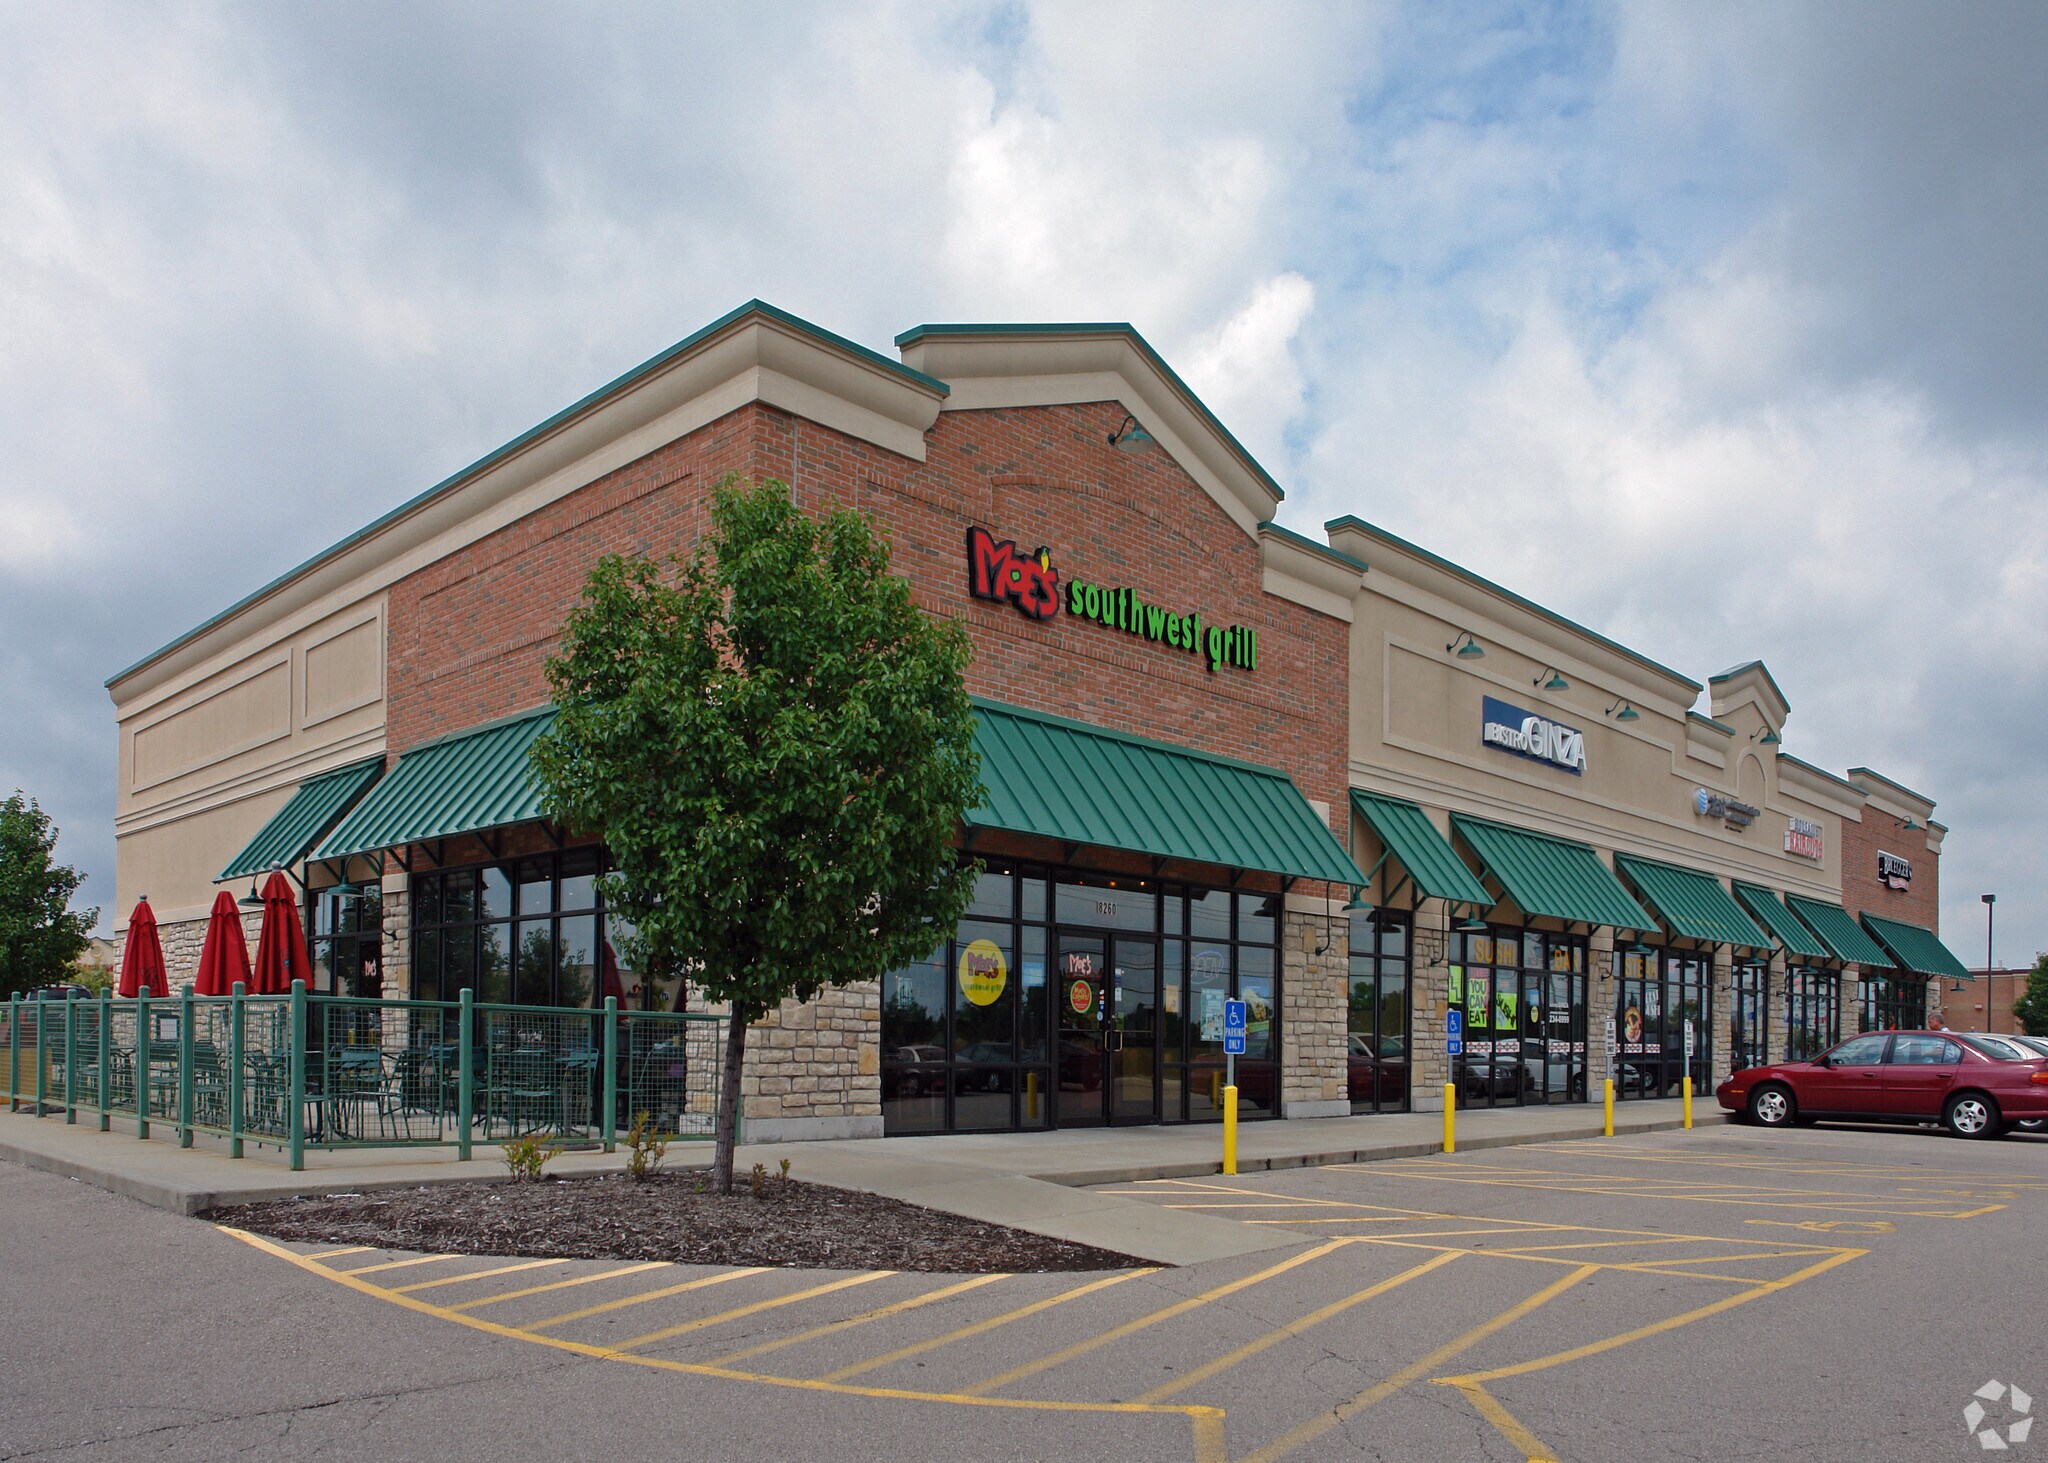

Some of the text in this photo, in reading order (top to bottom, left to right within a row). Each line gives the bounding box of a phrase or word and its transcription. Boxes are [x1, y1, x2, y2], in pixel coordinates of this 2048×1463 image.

[1066, 578, 1257, 672] southwest grill
[1485, 716, 1587, 771] BISTRO GINZA
[1474, 938, 1581, 973] SUSHI BAR
[1470, 980, 1487, 994] YOU
[1469, 994, 1487, 1009] CAN
[1469, 1009, 1487, 1024] EAT
[1225, 1027, 1244, 1037] PARKING
[1228, 1039, 1241, 1050] ONLY
